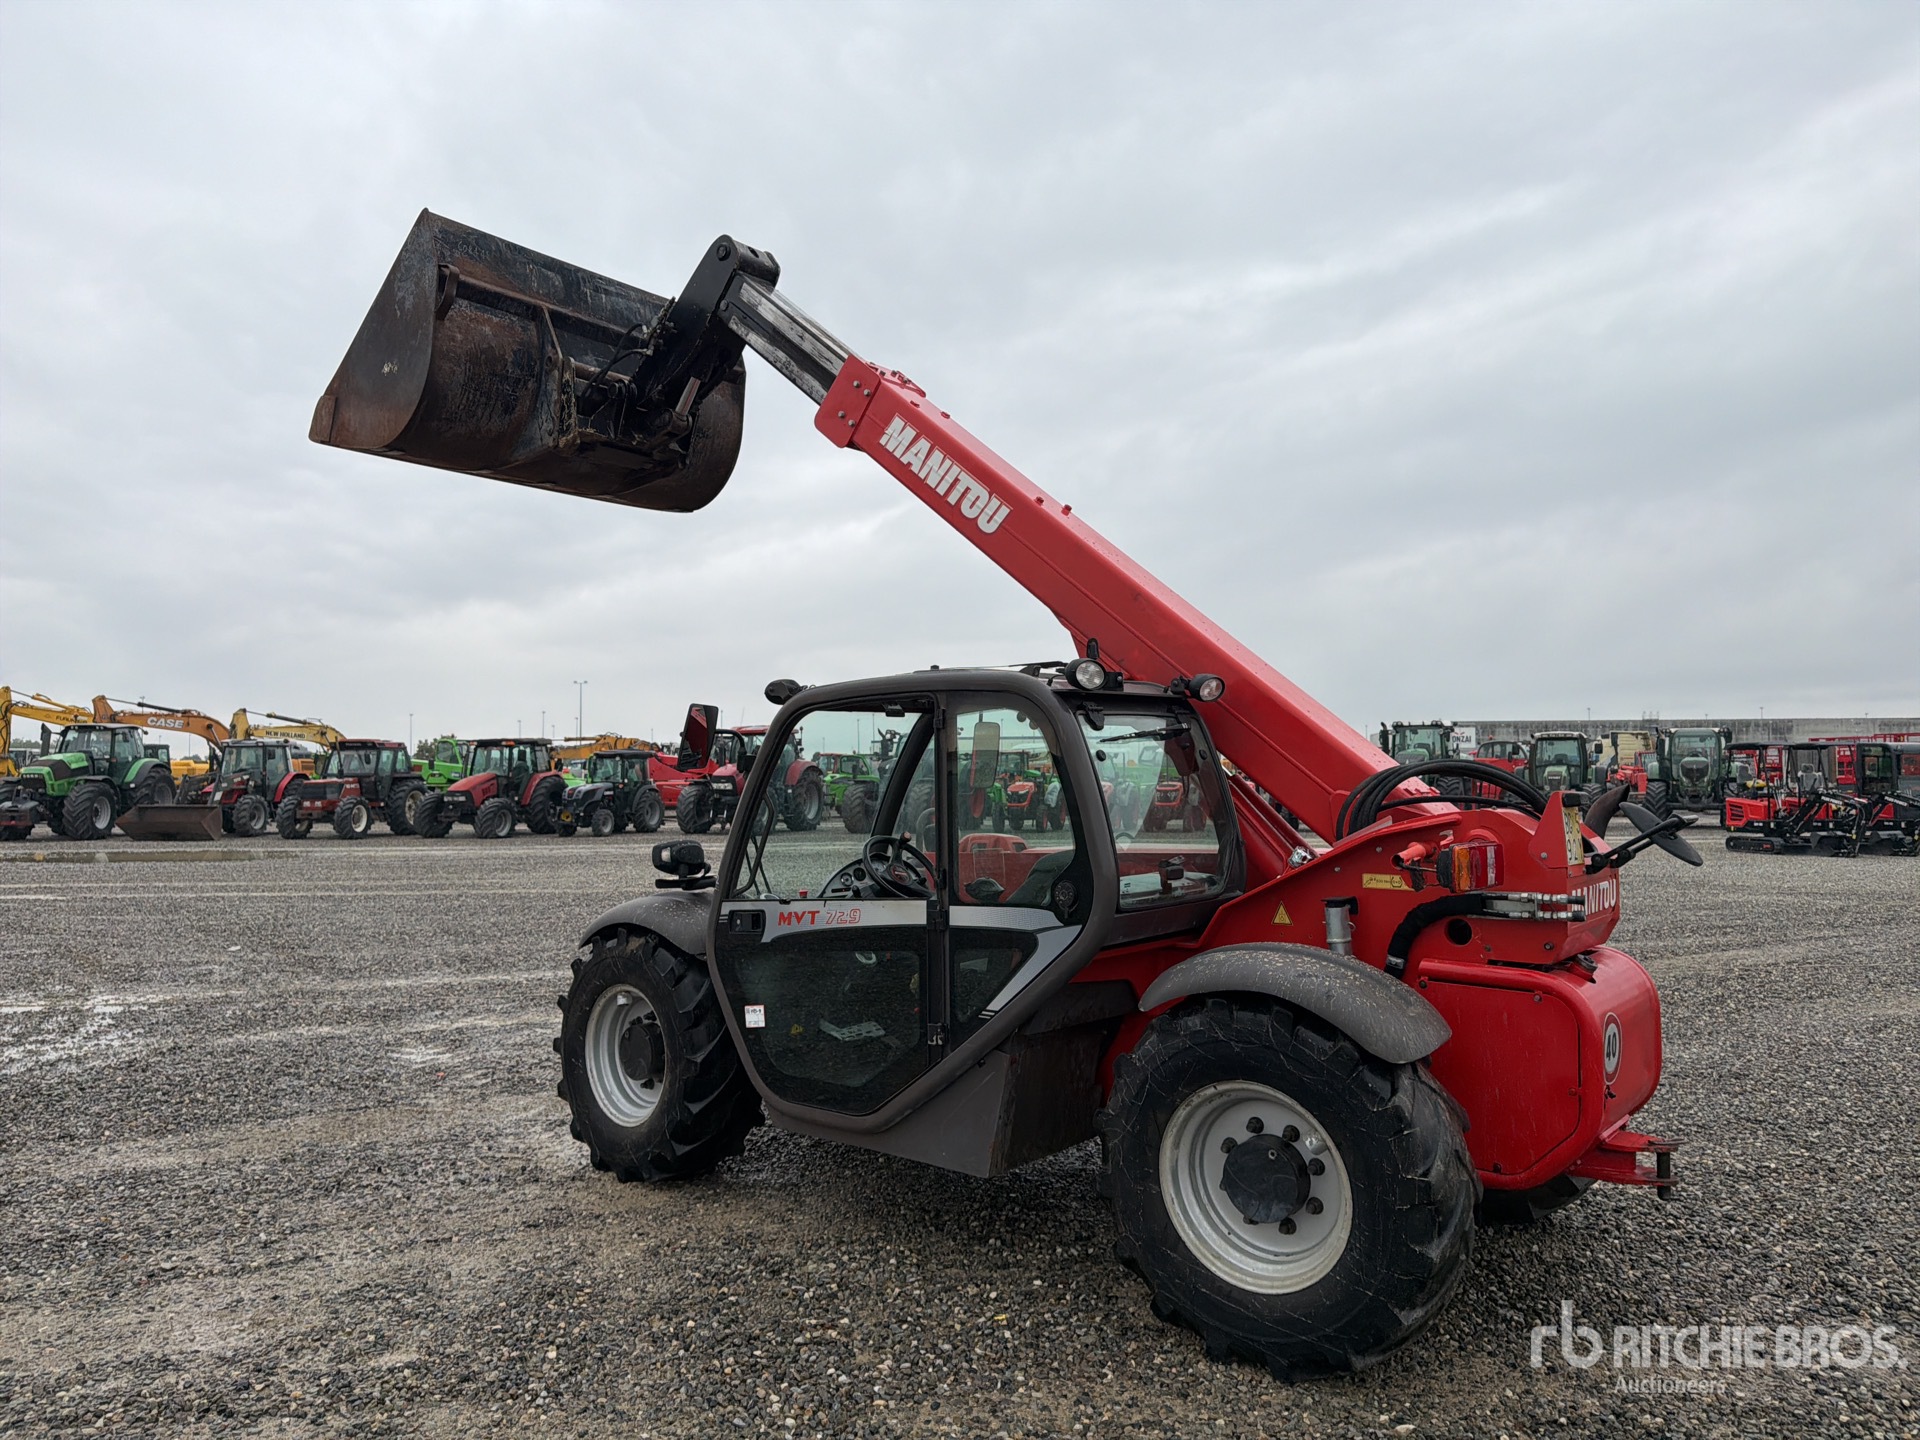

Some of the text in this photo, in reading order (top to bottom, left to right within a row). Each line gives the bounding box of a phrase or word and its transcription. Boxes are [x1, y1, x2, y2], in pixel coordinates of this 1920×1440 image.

[879, 413, 1012, 534] MANITOU
[147, 716, 184, 729] CASE
[777, 908, 861, 927] MVT 729
[1606, 1031, 1617, 1061] 40
